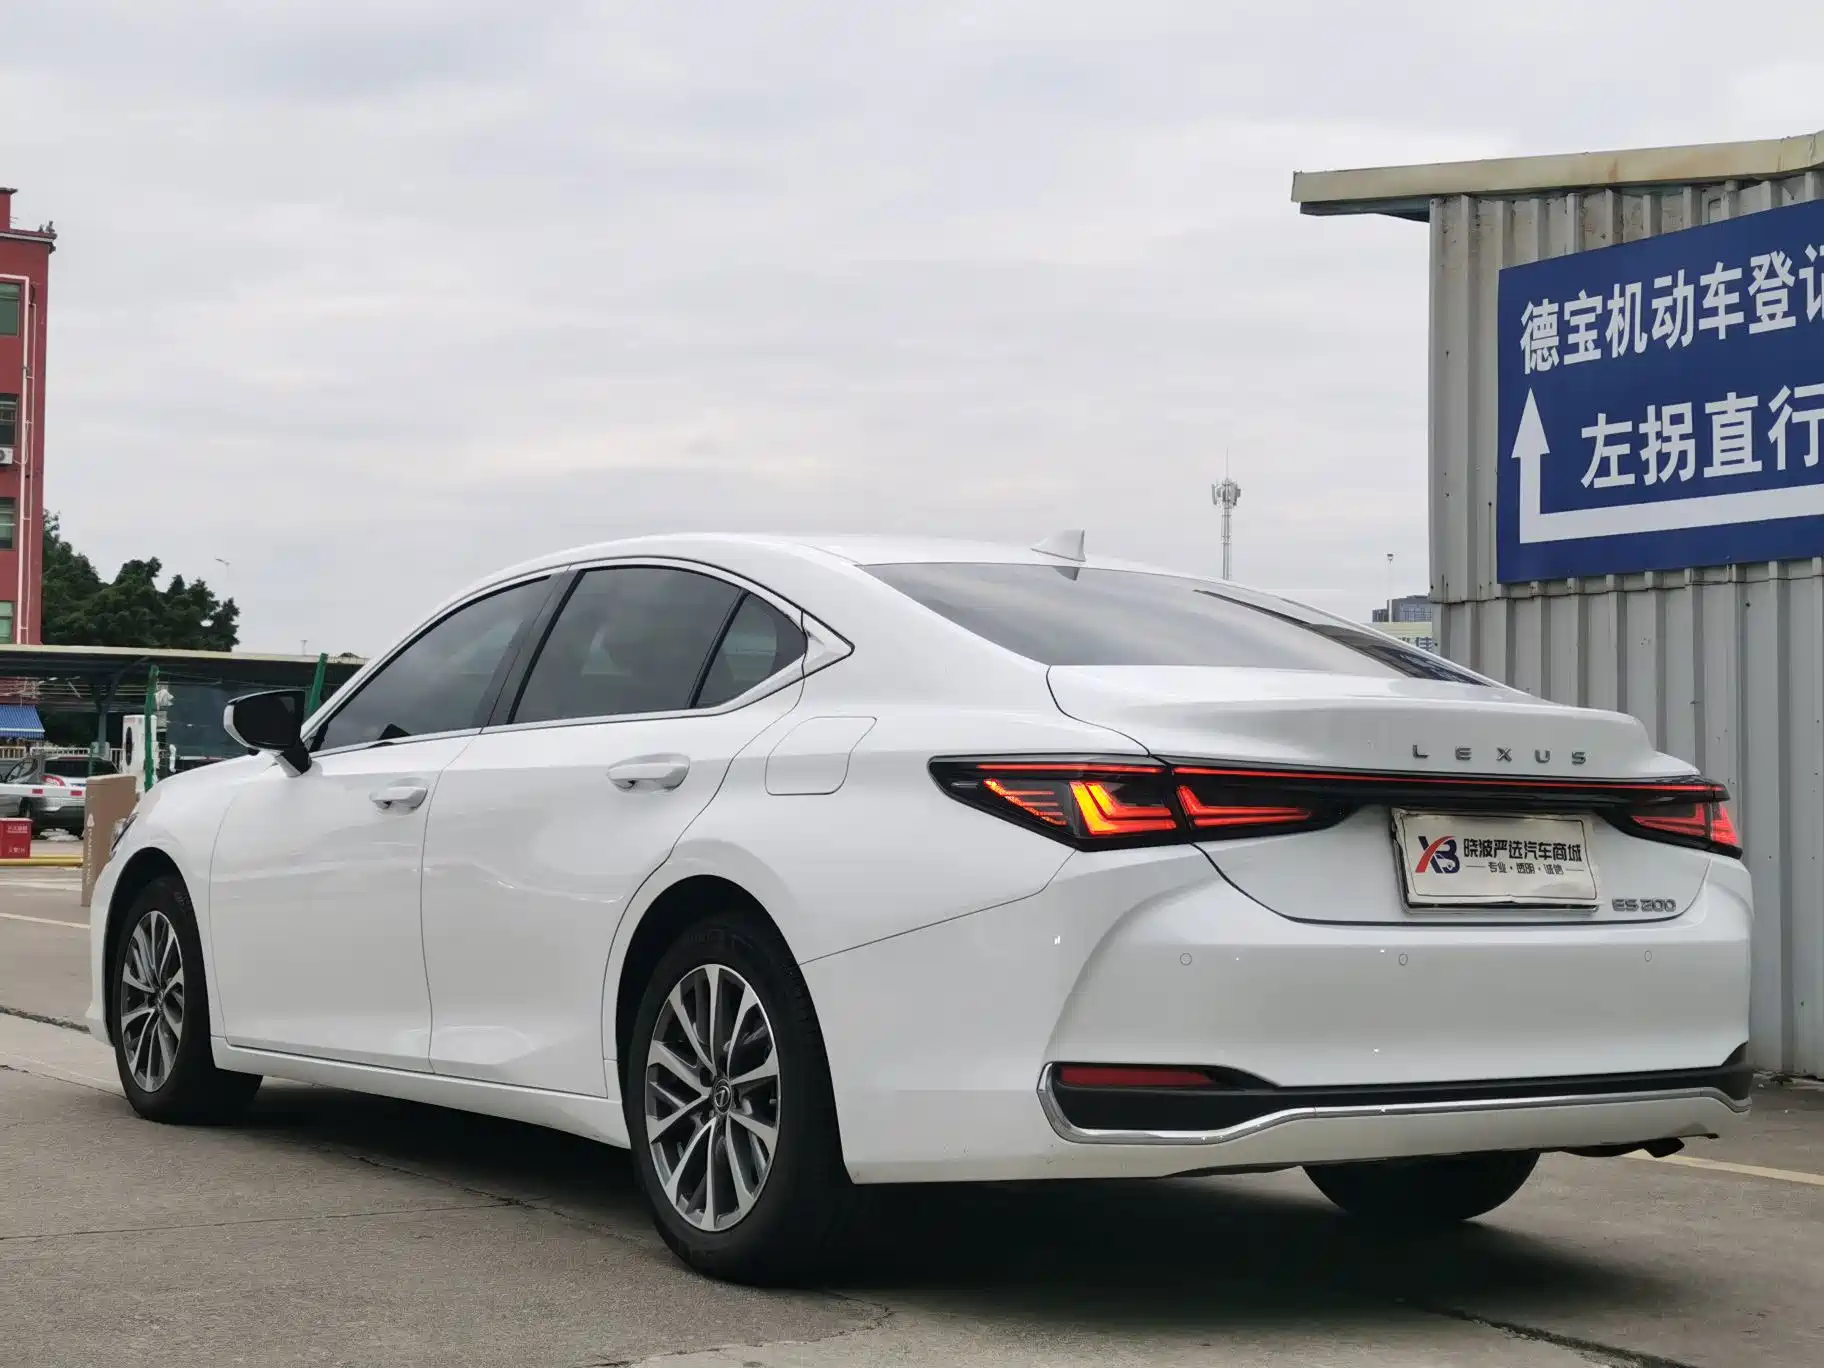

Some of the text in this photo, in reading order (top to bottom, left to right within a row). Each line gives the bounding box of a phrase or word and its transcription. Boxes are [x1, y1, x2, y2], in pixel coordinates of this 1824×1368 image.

[1580, 384, 1824, 489] 左拐直行
[1412, 744, 1587, 765] LEXUS
[1463, 838, 1582, 862] 晓波严选汽车商城
[1612, 898, 1676, 912] ES 200
